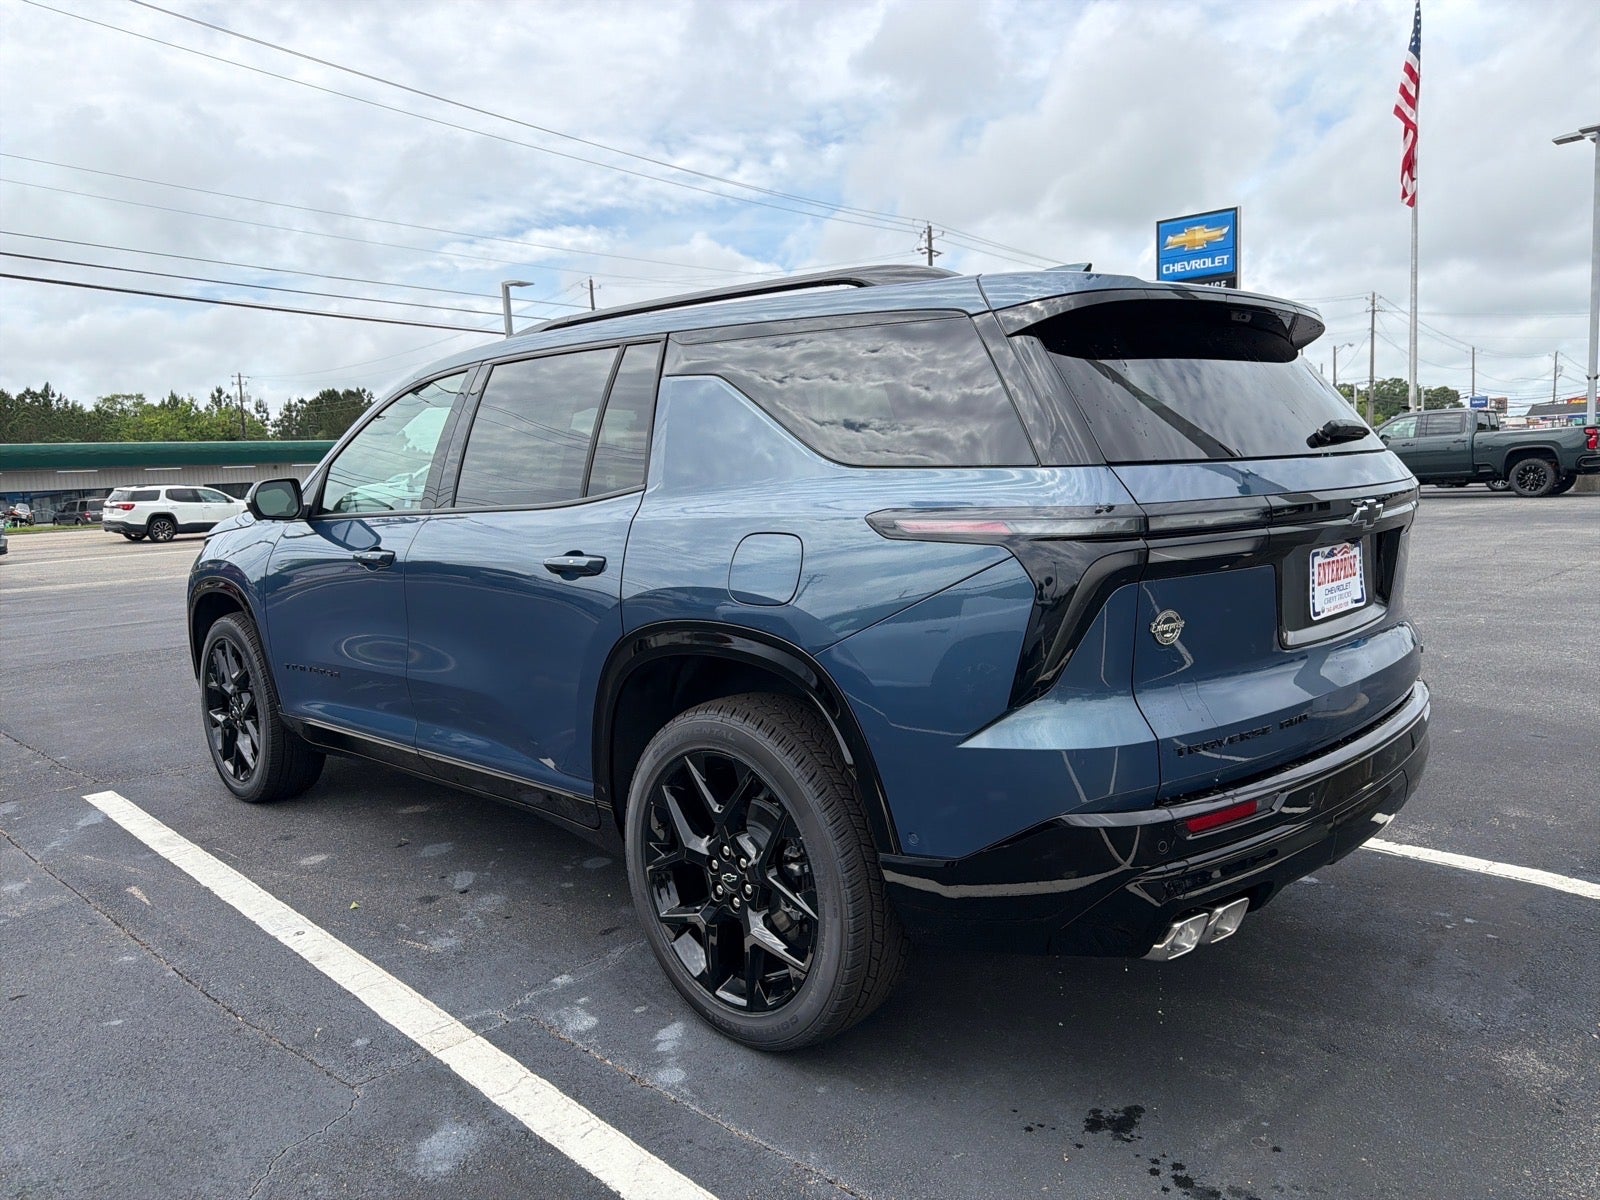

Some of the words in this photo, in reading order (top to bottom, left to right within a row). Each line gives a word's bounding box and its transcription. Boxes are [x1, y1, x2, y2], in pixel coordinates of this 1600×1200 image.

[1163, 255, 1229, 274] CHEVROLET
[1318, 555, 1357, 586] ENTERPRISE
[1325, 582, 1351, 595] CHEVROLET
[1175, 725, 1273, 757] TRAVERSE
